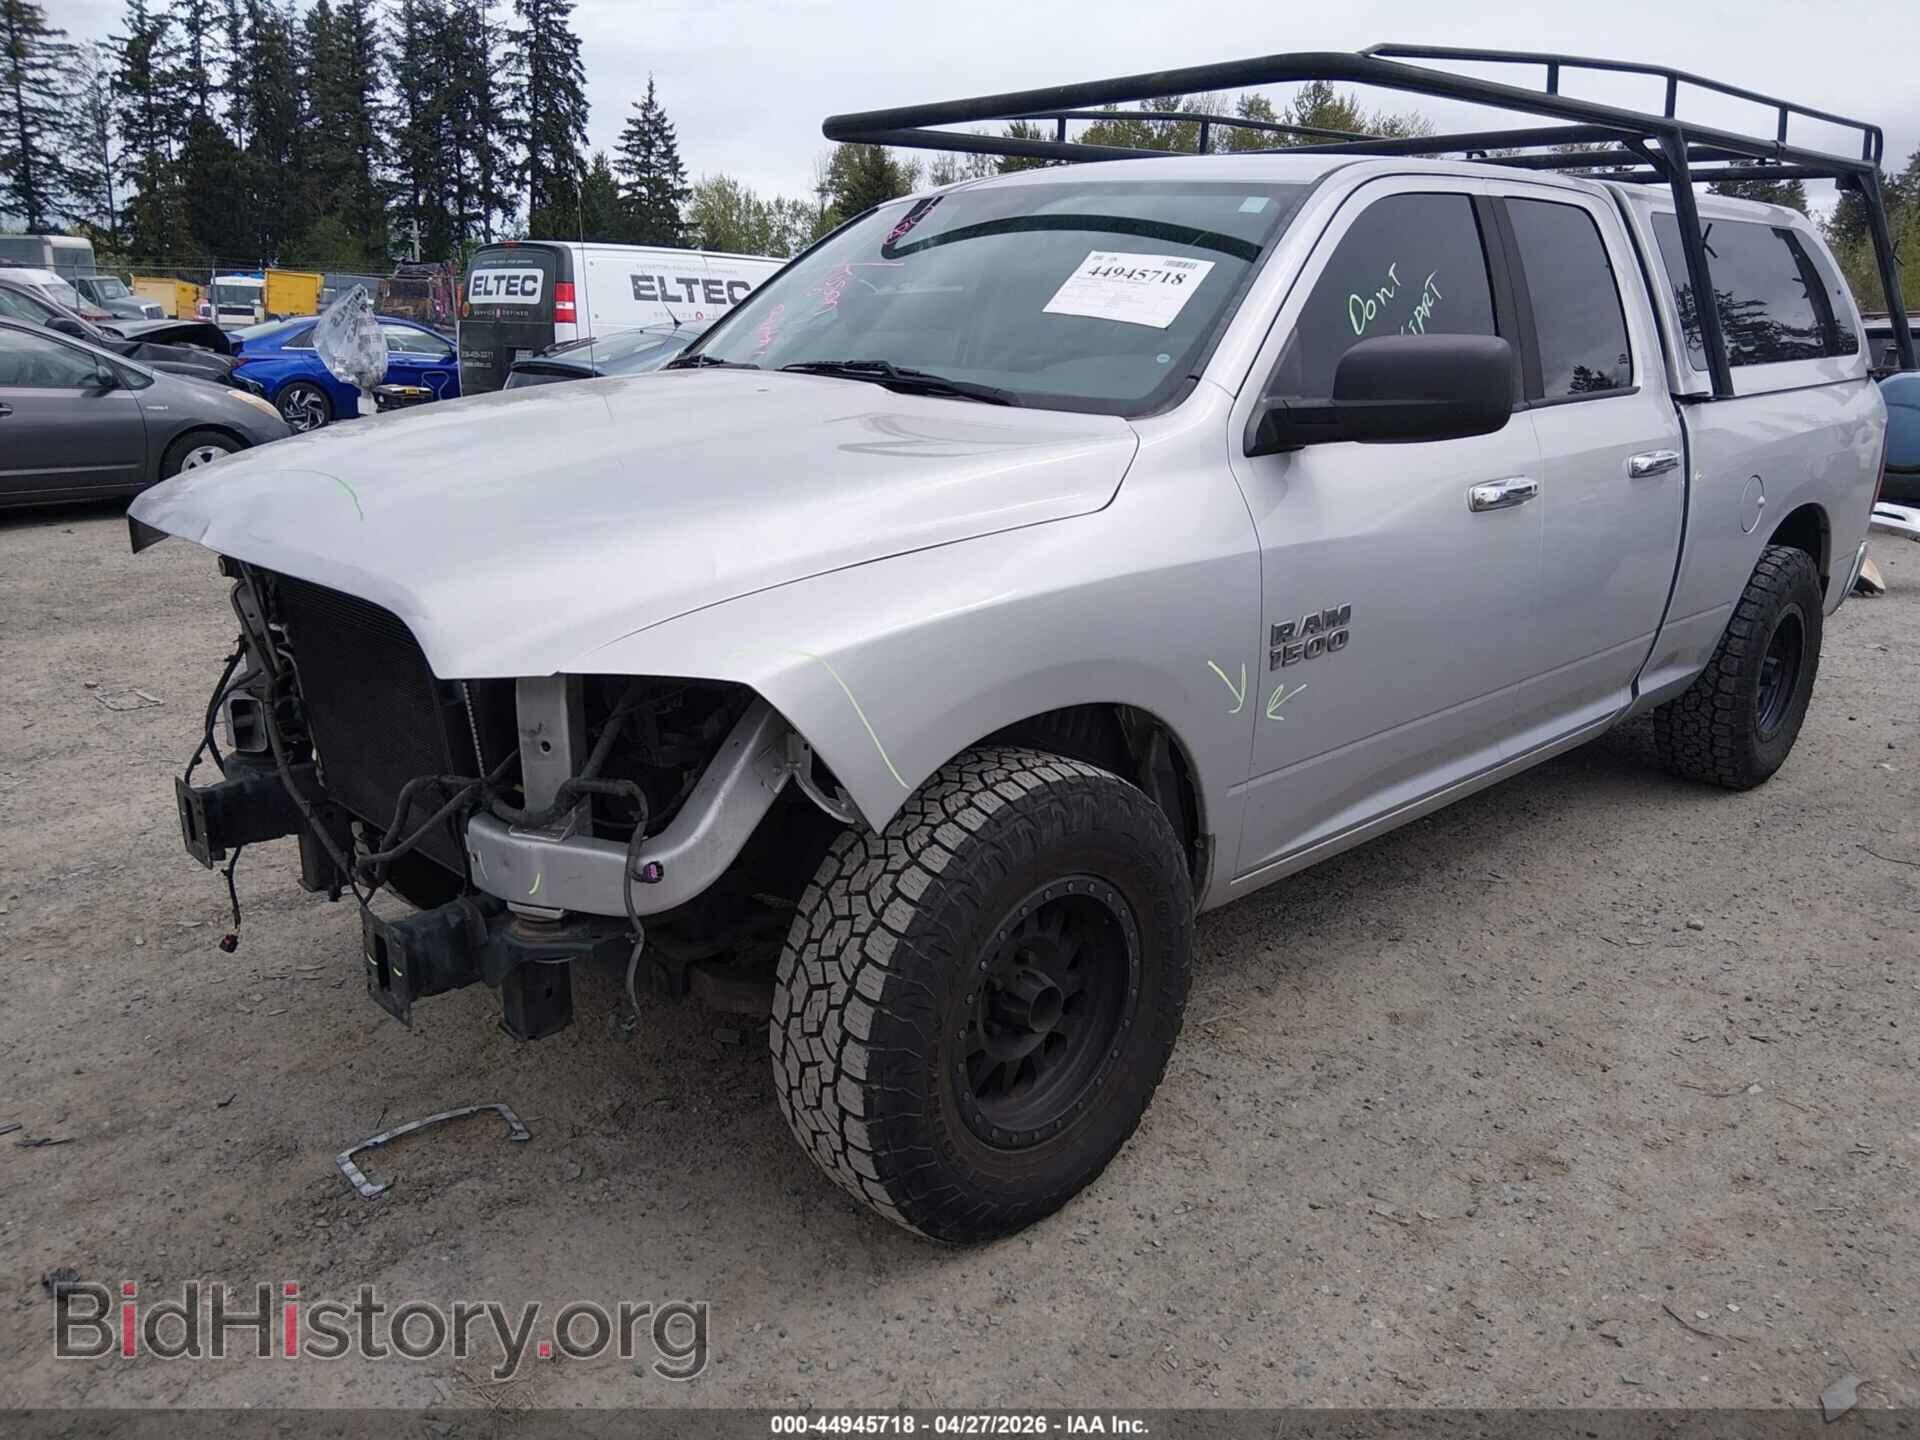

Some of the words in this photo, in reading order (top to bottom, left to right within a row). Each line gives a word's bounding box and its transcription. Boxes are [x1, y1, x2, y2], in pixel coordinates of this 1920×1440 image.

[472, 275, 539, 297] ELTEC
[630, 274, 752, 306] ELTEC
[1088, 265, 1187, 286] 44945718
[1271, 602, 1352, 648] RAM
[1269, 628, 1350, 672] 1500
